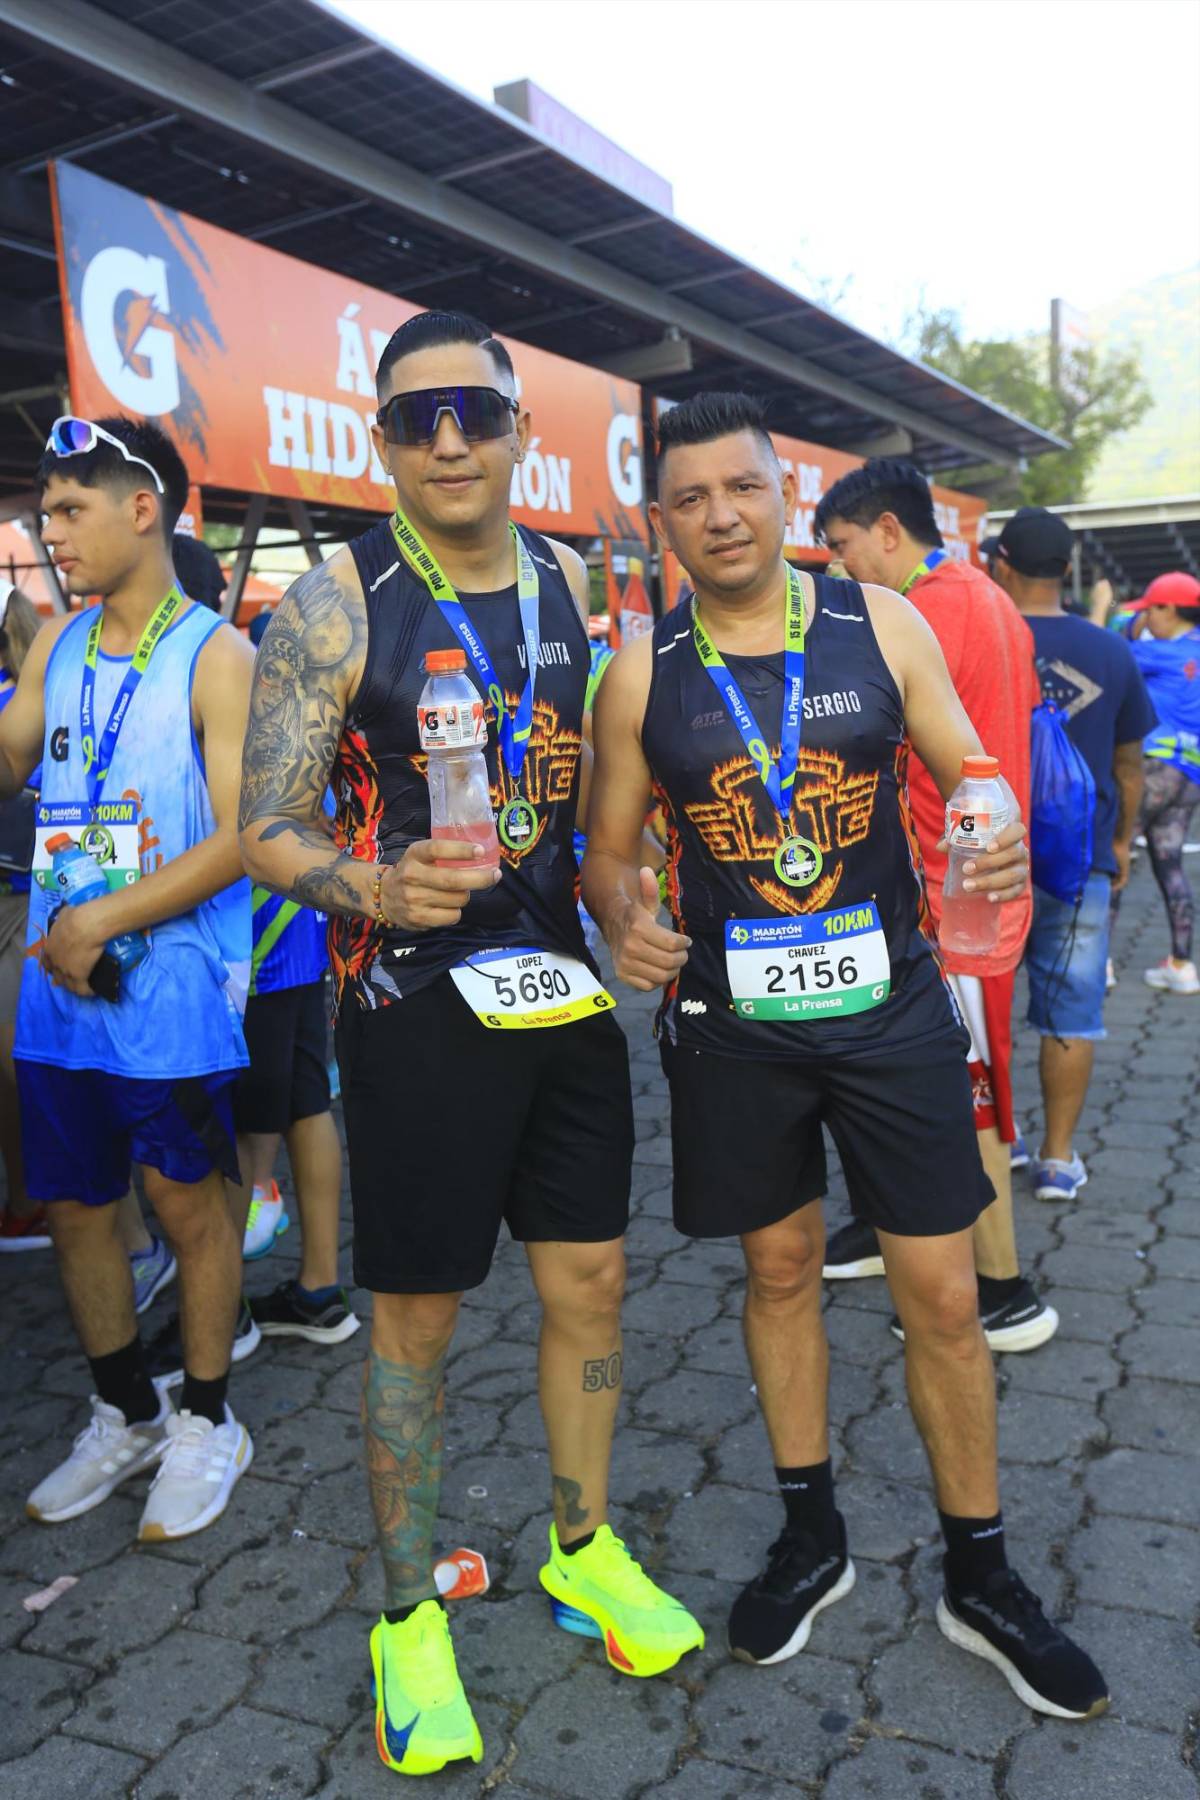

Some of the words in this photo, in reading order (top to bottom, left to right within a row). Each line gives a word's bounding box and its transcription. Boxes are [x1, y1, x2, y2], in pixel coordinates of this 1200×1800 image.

[81, 246, 180, 416] G
[398, 525, 420, 553] MENTE
[416, 551, 434, 573] UNA
[429, 570, 445, 592] POR
[791, 594, 801, 618] JUNIO
[790, 618, 801, 629] DE
[459, 622, 480, 659] Prensa
[790, 630, 801, 639] 15
[516, 642, 571, 669] VQUITA
[701, 643, 713, 660] POR
[479, 657, 489, 673] La
[83, 685, 91, 713] Prensa
[725, 684, 746, 717] Prensa
[788, 677, 801, 711] Prensa
[109, 720, 118, 733] La
[114, 692, 129, 723] Prensa
[802, 690, 862, 720] SERGIO
[82, 714, 90, 726] La
[425, 711, 439, 731] G
[741, 715, 752, 730] La
[787, 713, 798, 726] La
[96, 804, 133, 821] 10KM
[960, 815, 975, 833] G
[752, 923, 802, 937] MARATÓN
[823, 908, 874, 936] 10KM
[788, 945, 826, 959] CHAVEZ
[516, 956, 543, 970] LOPEZ
[765, 956, 858, 994] 2156
[494, 968, 571, 1007] 5690
[872, 984, 884, 1001] G
[593, 995, 609, 1008] G
[741, 1001, 755, 1014] G
[784, 1001, 800, 1012] La
[802, 997, 843, 1011] Prensa
[486, 1015, 502, 1026] G
[521, 1016, 535, 1026] La
[536, 1011, 572, 1025] Prensa
[582, 1351, 622, 1393] 50
